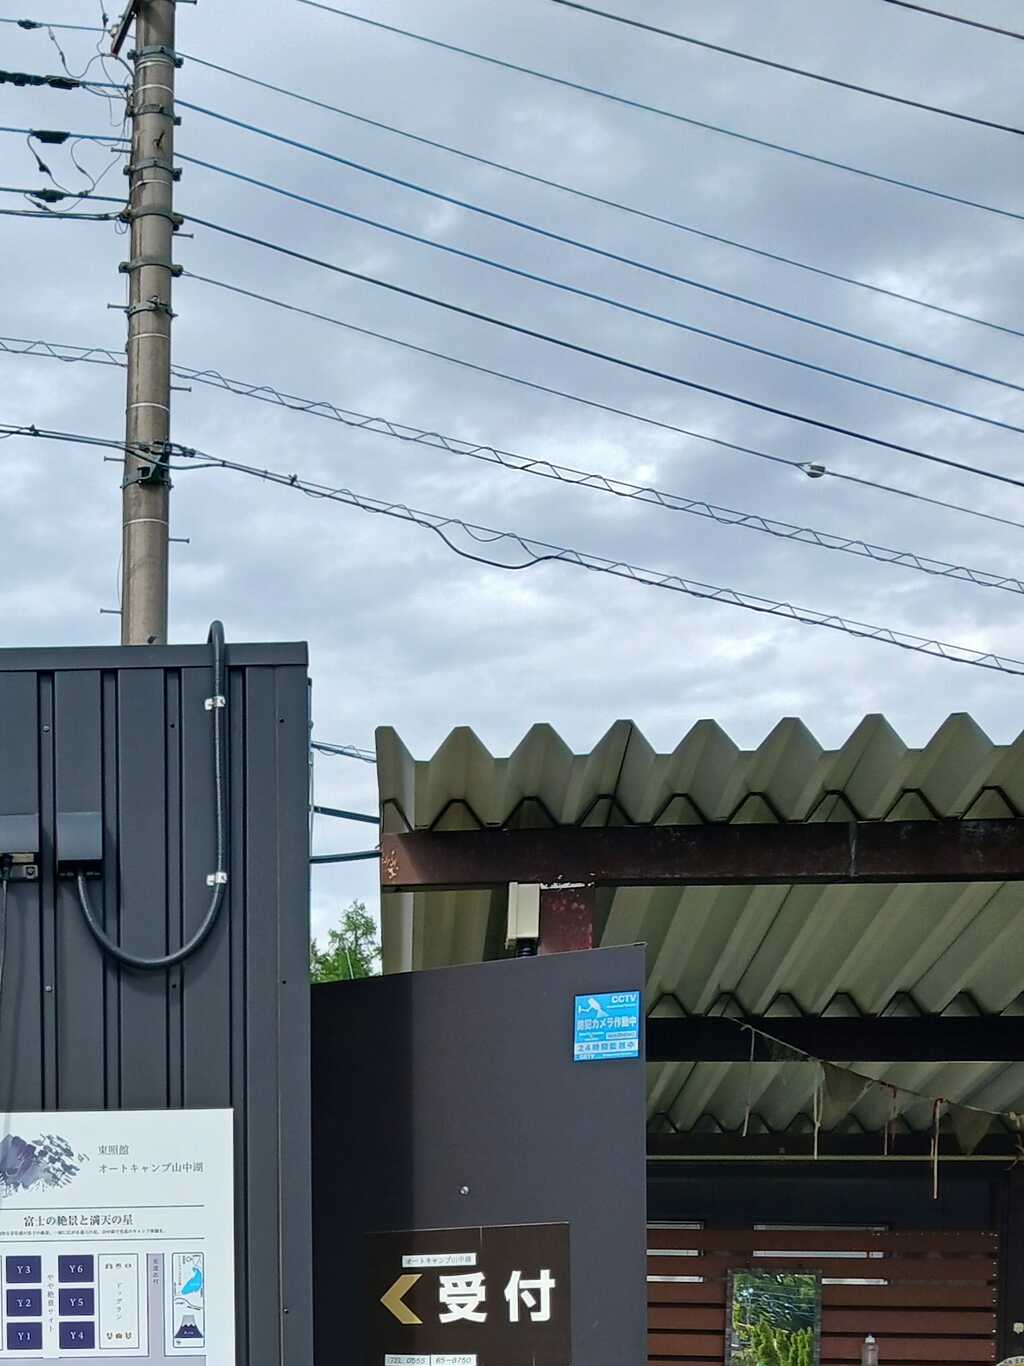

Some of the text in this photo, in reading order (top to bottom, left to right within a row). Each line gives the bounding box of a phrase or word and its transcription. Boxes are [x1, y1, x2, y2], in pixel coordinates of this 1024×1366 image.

[612, 995, 636, 1003] CCTV
[98, 1144, 129, 1156] 東照館
[98, 1162, 204, 1174] オートキャンプ山中湖
[24, 1214, 134, 1227] 富士の絶景と満天の星
[439, 1269, 556, 1324] 受付
